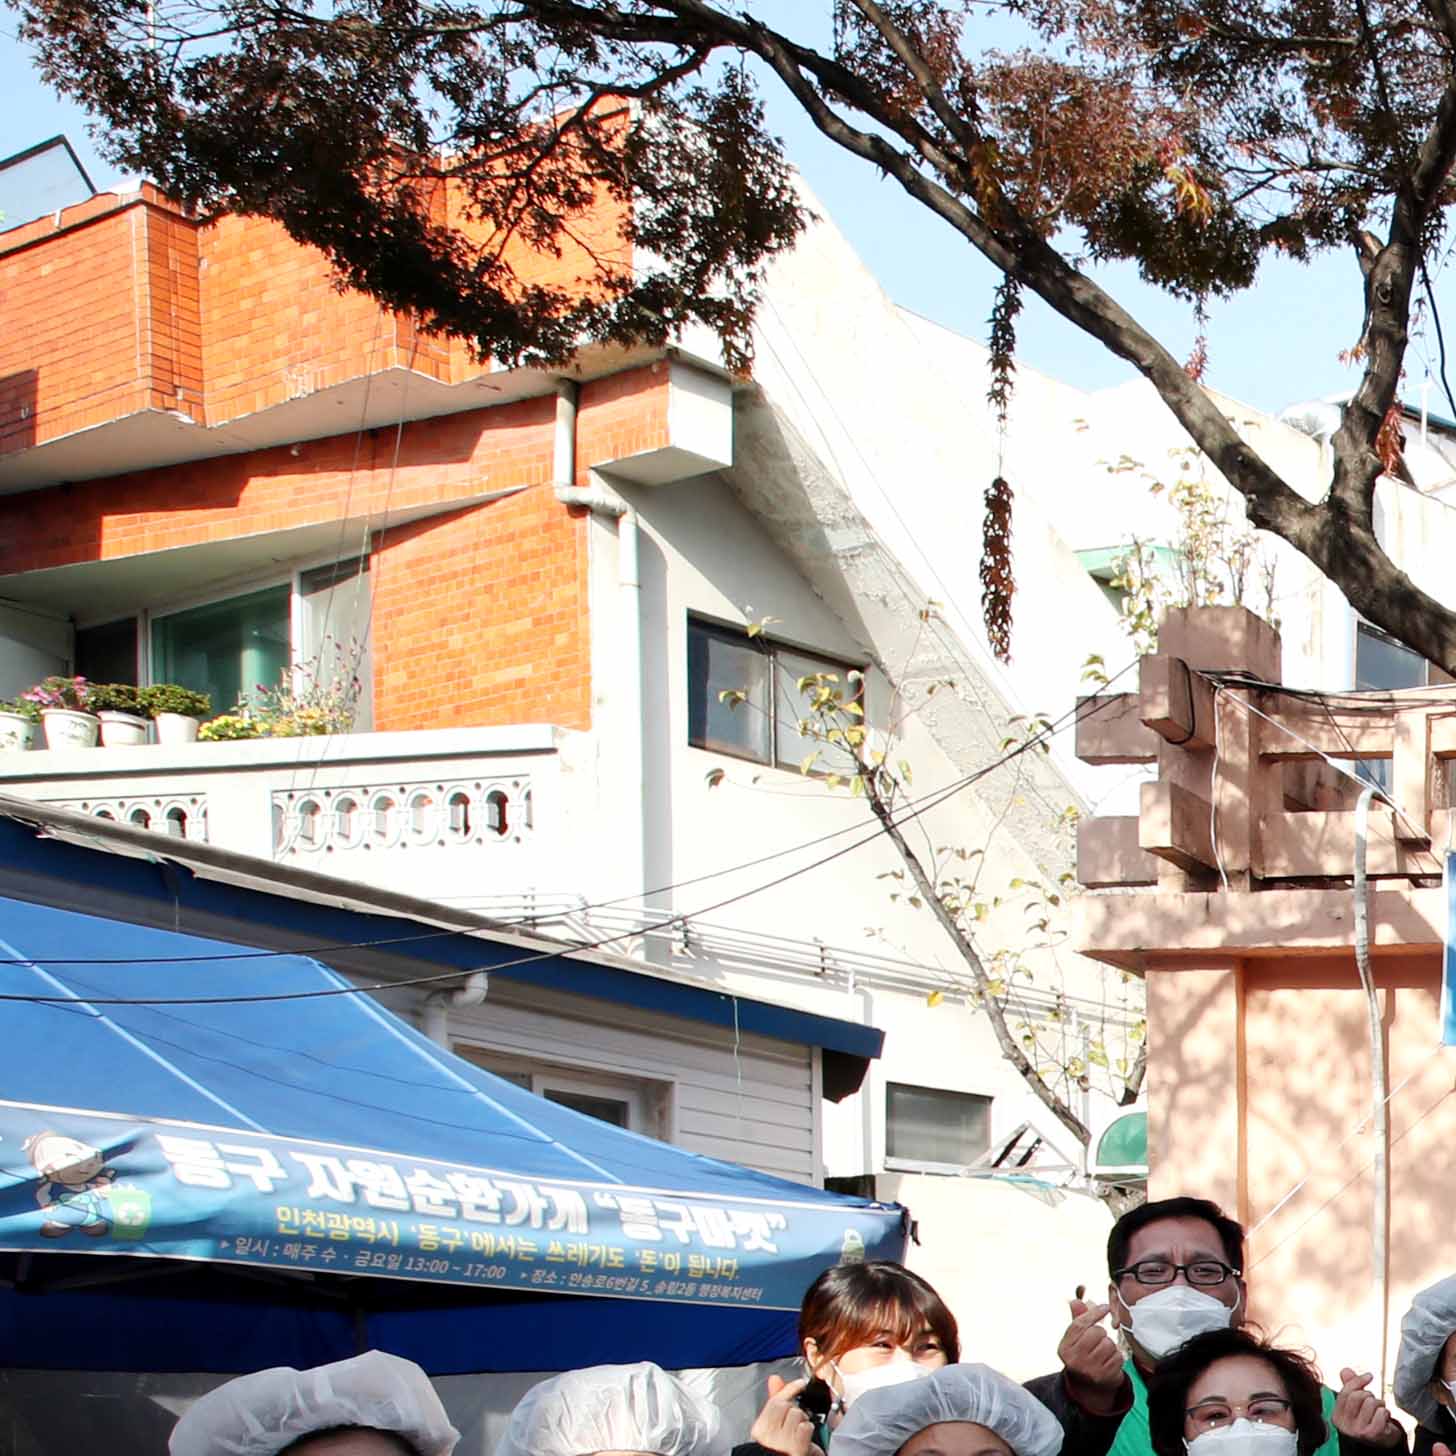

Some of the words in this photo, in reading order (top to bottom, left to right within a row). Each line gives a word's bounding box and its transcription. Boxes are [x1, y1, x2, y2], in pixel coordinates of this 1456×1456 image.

[155, 1133, 288, 1193] 동구
[290, 1150, 590, 1235] 자원순환가게
[234, 1236, 270, 1257] 일시
[283, 1242, 317, 1260] 매주
[320, 1246, 337, 1263] 수
[354, 1248, 403, 1270] 금요일
[405, 1256, 449, 1274] 13:00
[464, 1263, 506, 1280] 17:00
[275, 1205, 399, 1247] 인천광역시
[545, 1239, 625, 1269] 쓰레기도
[687, 1254, 741, 1281] 됩니다.
[531, 1268, 559, 1285] 장소
